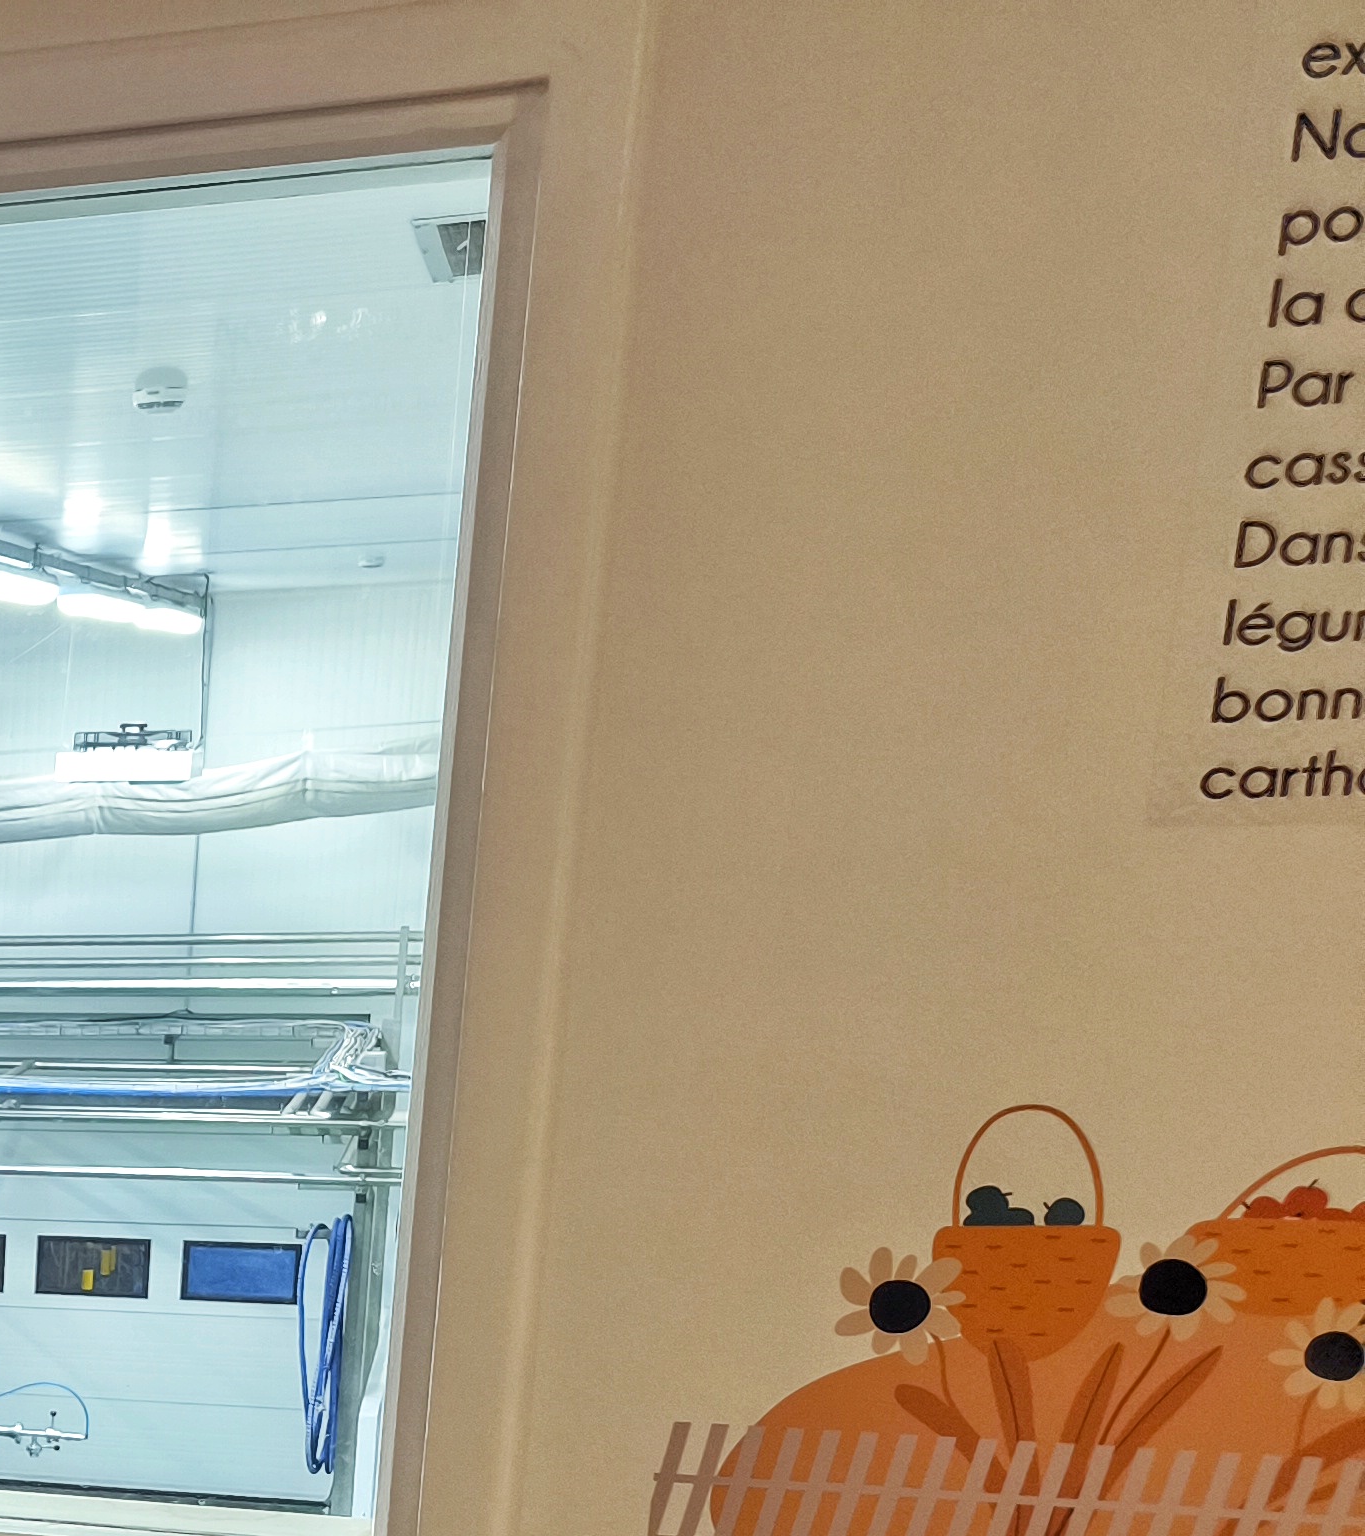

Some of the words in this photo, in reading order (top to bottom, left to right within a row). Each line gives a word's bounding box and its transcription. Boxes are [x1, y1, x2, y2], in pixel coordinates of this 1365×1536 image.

[1277, 205, 1365, 256] po
[1268, 278, 1325, 328] la
[1257, 359, 1355, 409] Par
[1234, 519, 1365, 568] Dan
[1223, 599, 1365, 652] légu
[1211, 676, 1363, 724] bonn
[1199, 749, 1365, 800] carth
